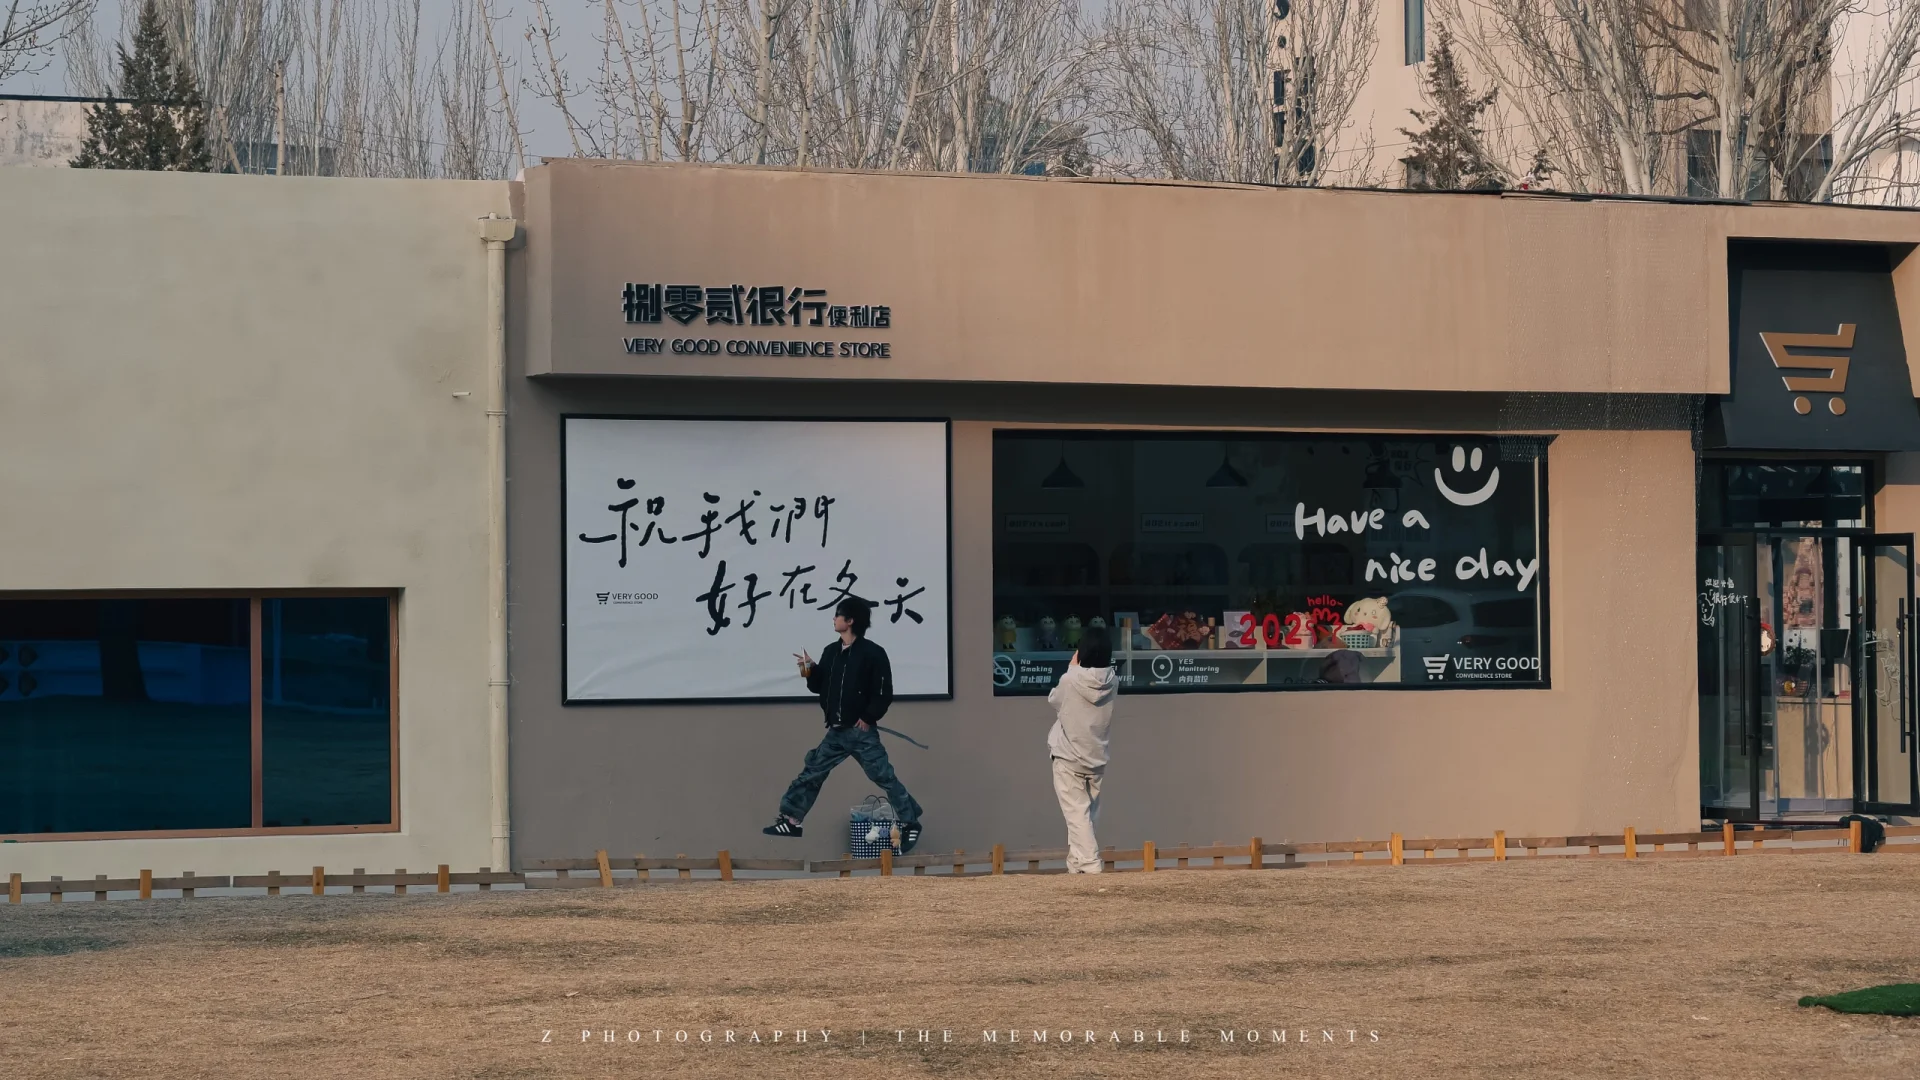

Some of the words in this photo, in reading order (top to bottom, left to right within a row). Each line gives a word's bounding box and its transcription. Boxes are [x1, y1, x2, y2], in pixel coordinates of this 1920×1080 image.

[622, 337, 666, 356] VERY
[671, 338, 722, 357] GOOD
[726, 339, 835, 358] CONVENIENCE
[839, 341, 891, 359] STORE
[1294, 502, 1385, 540] Have
[1402, 509, 1430, 529] a
[1365, 552, 1437, 584] nice
[1455, 547, 1538, 592] day
[611, 592, 633, 601] VERY
[633, 592, 660, 601] GOOD
[1020, 666, 1053, 674] Smoking
[1453, 657, 1492, 670] VERY
[1495, 657, 1541, 670] GOOD
[1178, 666, 1220, 675] Monitoring
